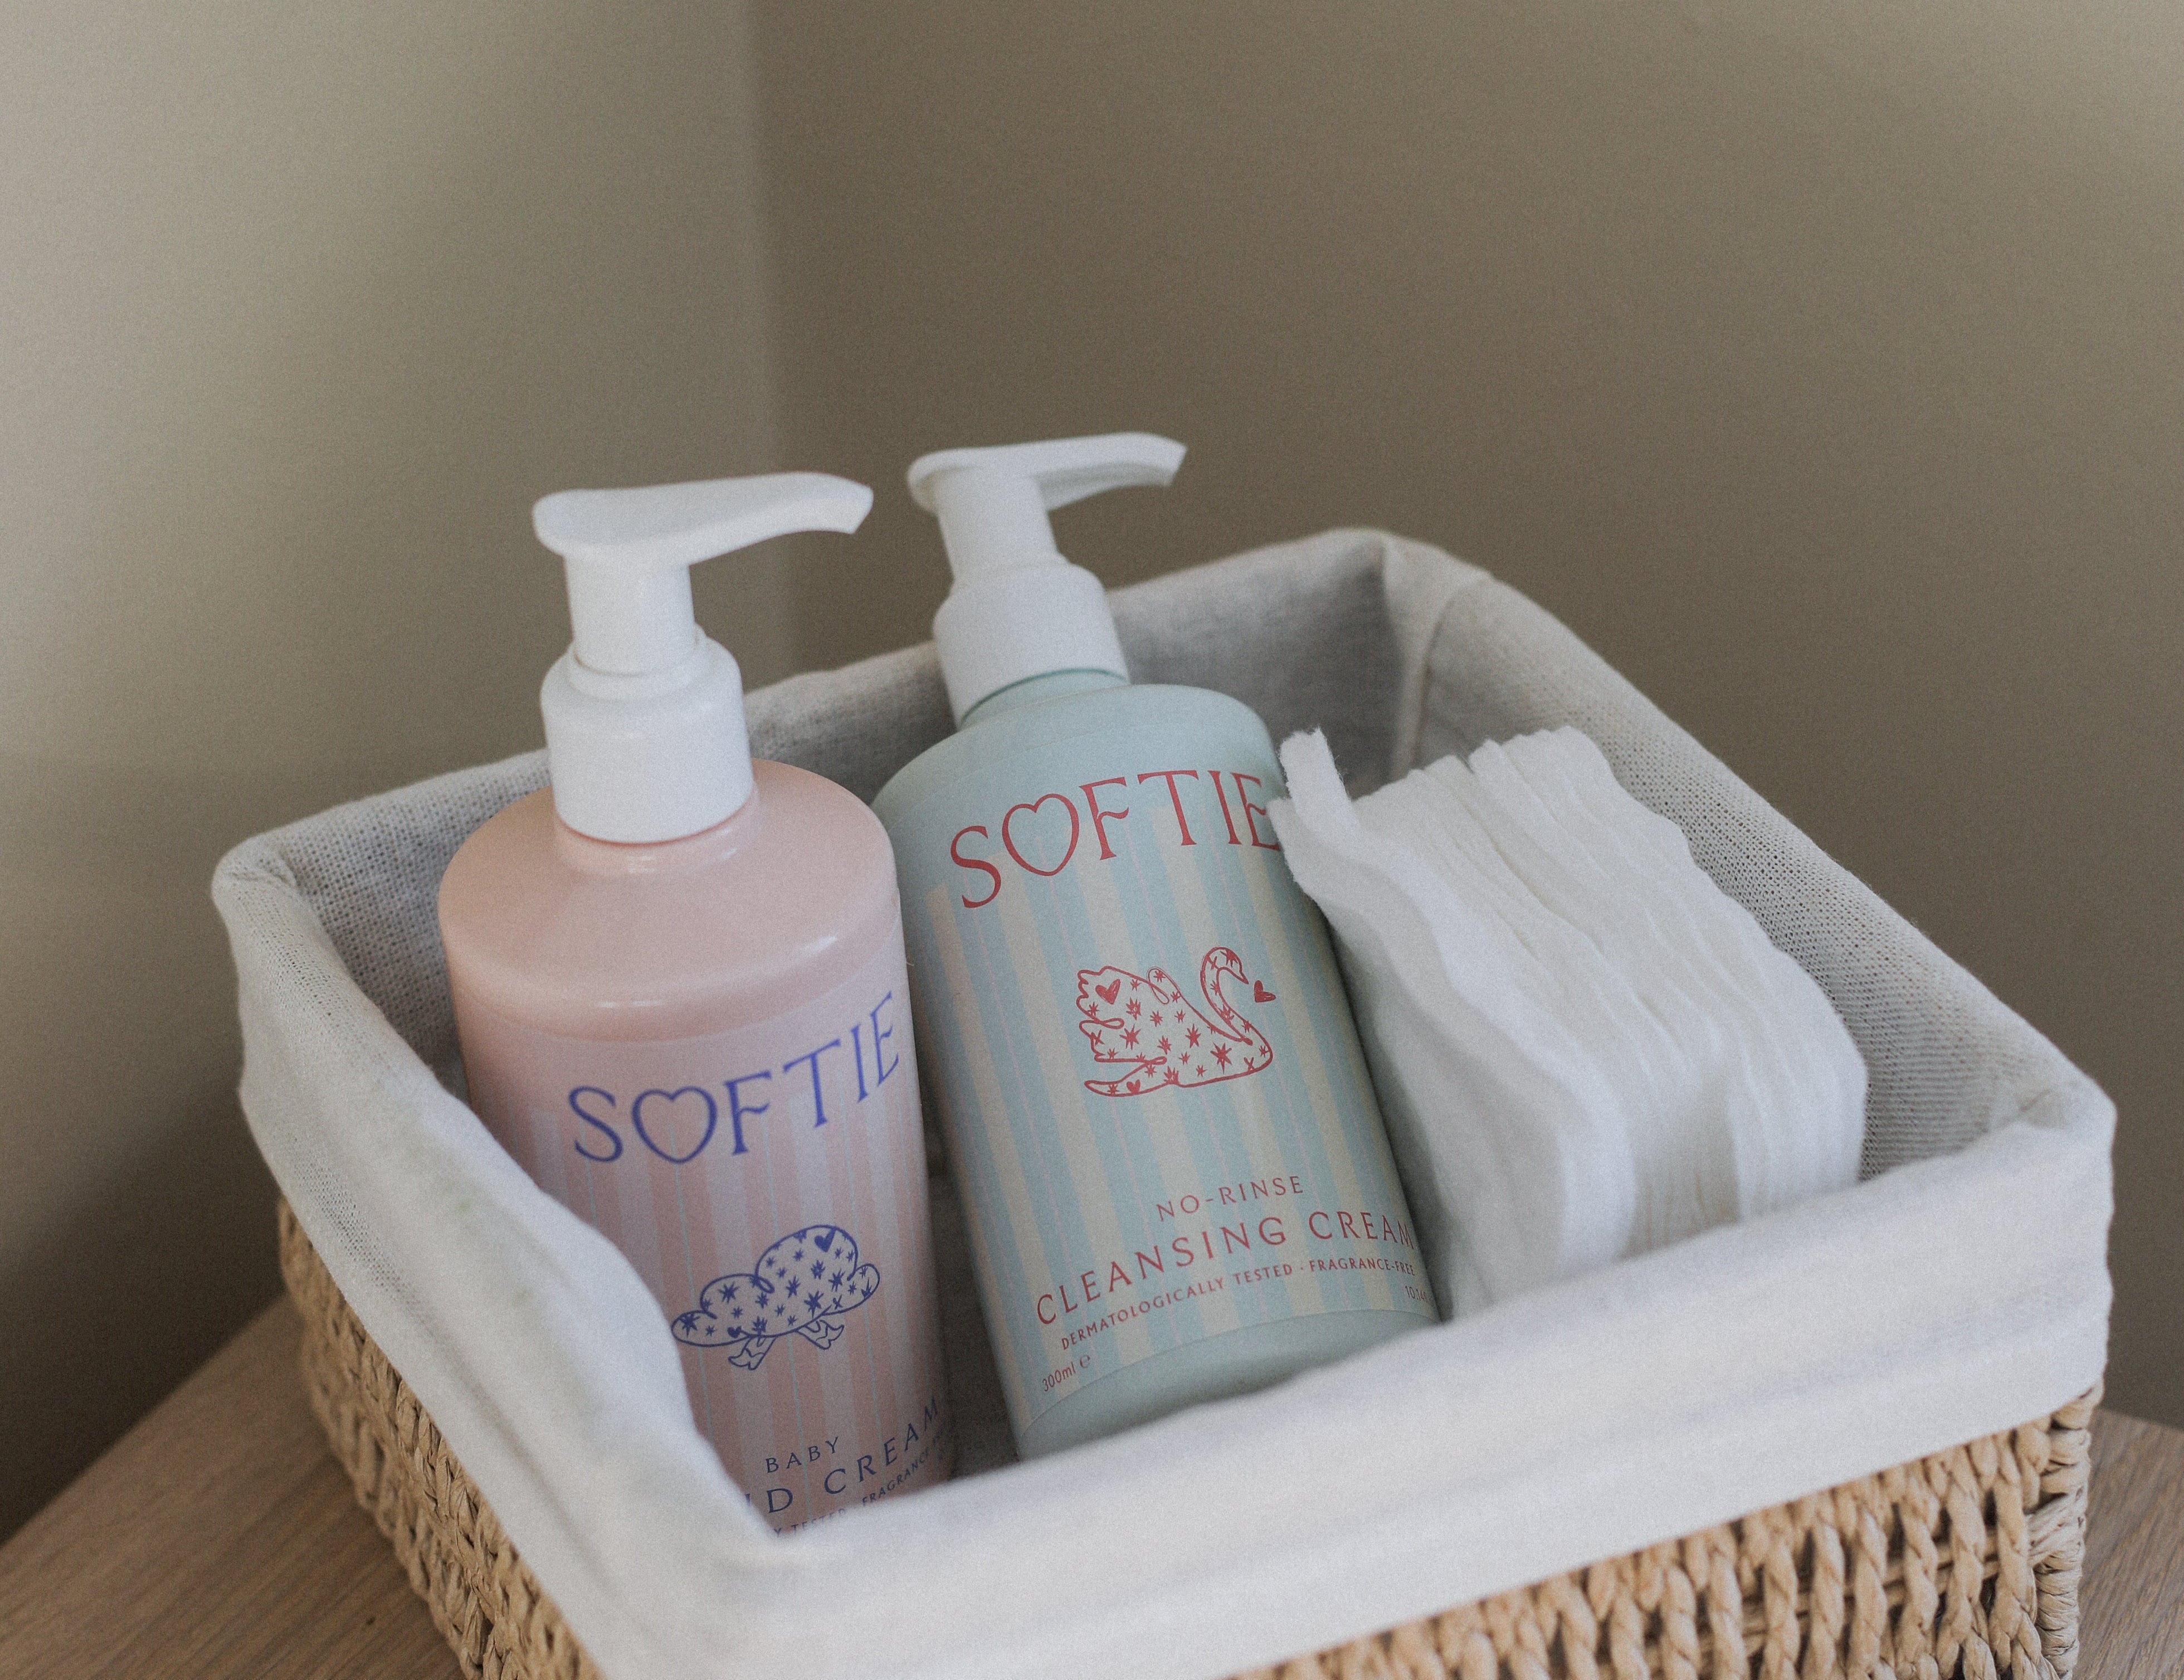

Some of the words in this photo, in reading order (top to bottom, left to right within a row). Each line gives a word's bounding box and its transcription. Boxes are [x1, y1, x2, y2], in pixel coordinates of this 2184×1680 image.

[950, 770, 1280, 908] SOFTIE
[568, 990, 899, 1164] SOFTIE
[1156, 1176, 1304, 1222] NO-RINSE
[1037, 1216, 1286, 1324] CLEANSING
[1309, 1211, 1415, 1250] CREAM
[1061, 1277, 1224, 1351] DERMATOLOGICALLY
[1232, 1264, 1293, 1285] TESTED
[1309, 1257, 1416, 1277] FRAGRANCE-FREE
[1042, 1361, 1076, 1392] 300ml
[765, 1436, 839, 1473] BABY
[823, 1396, 939, 1495] CREAM
